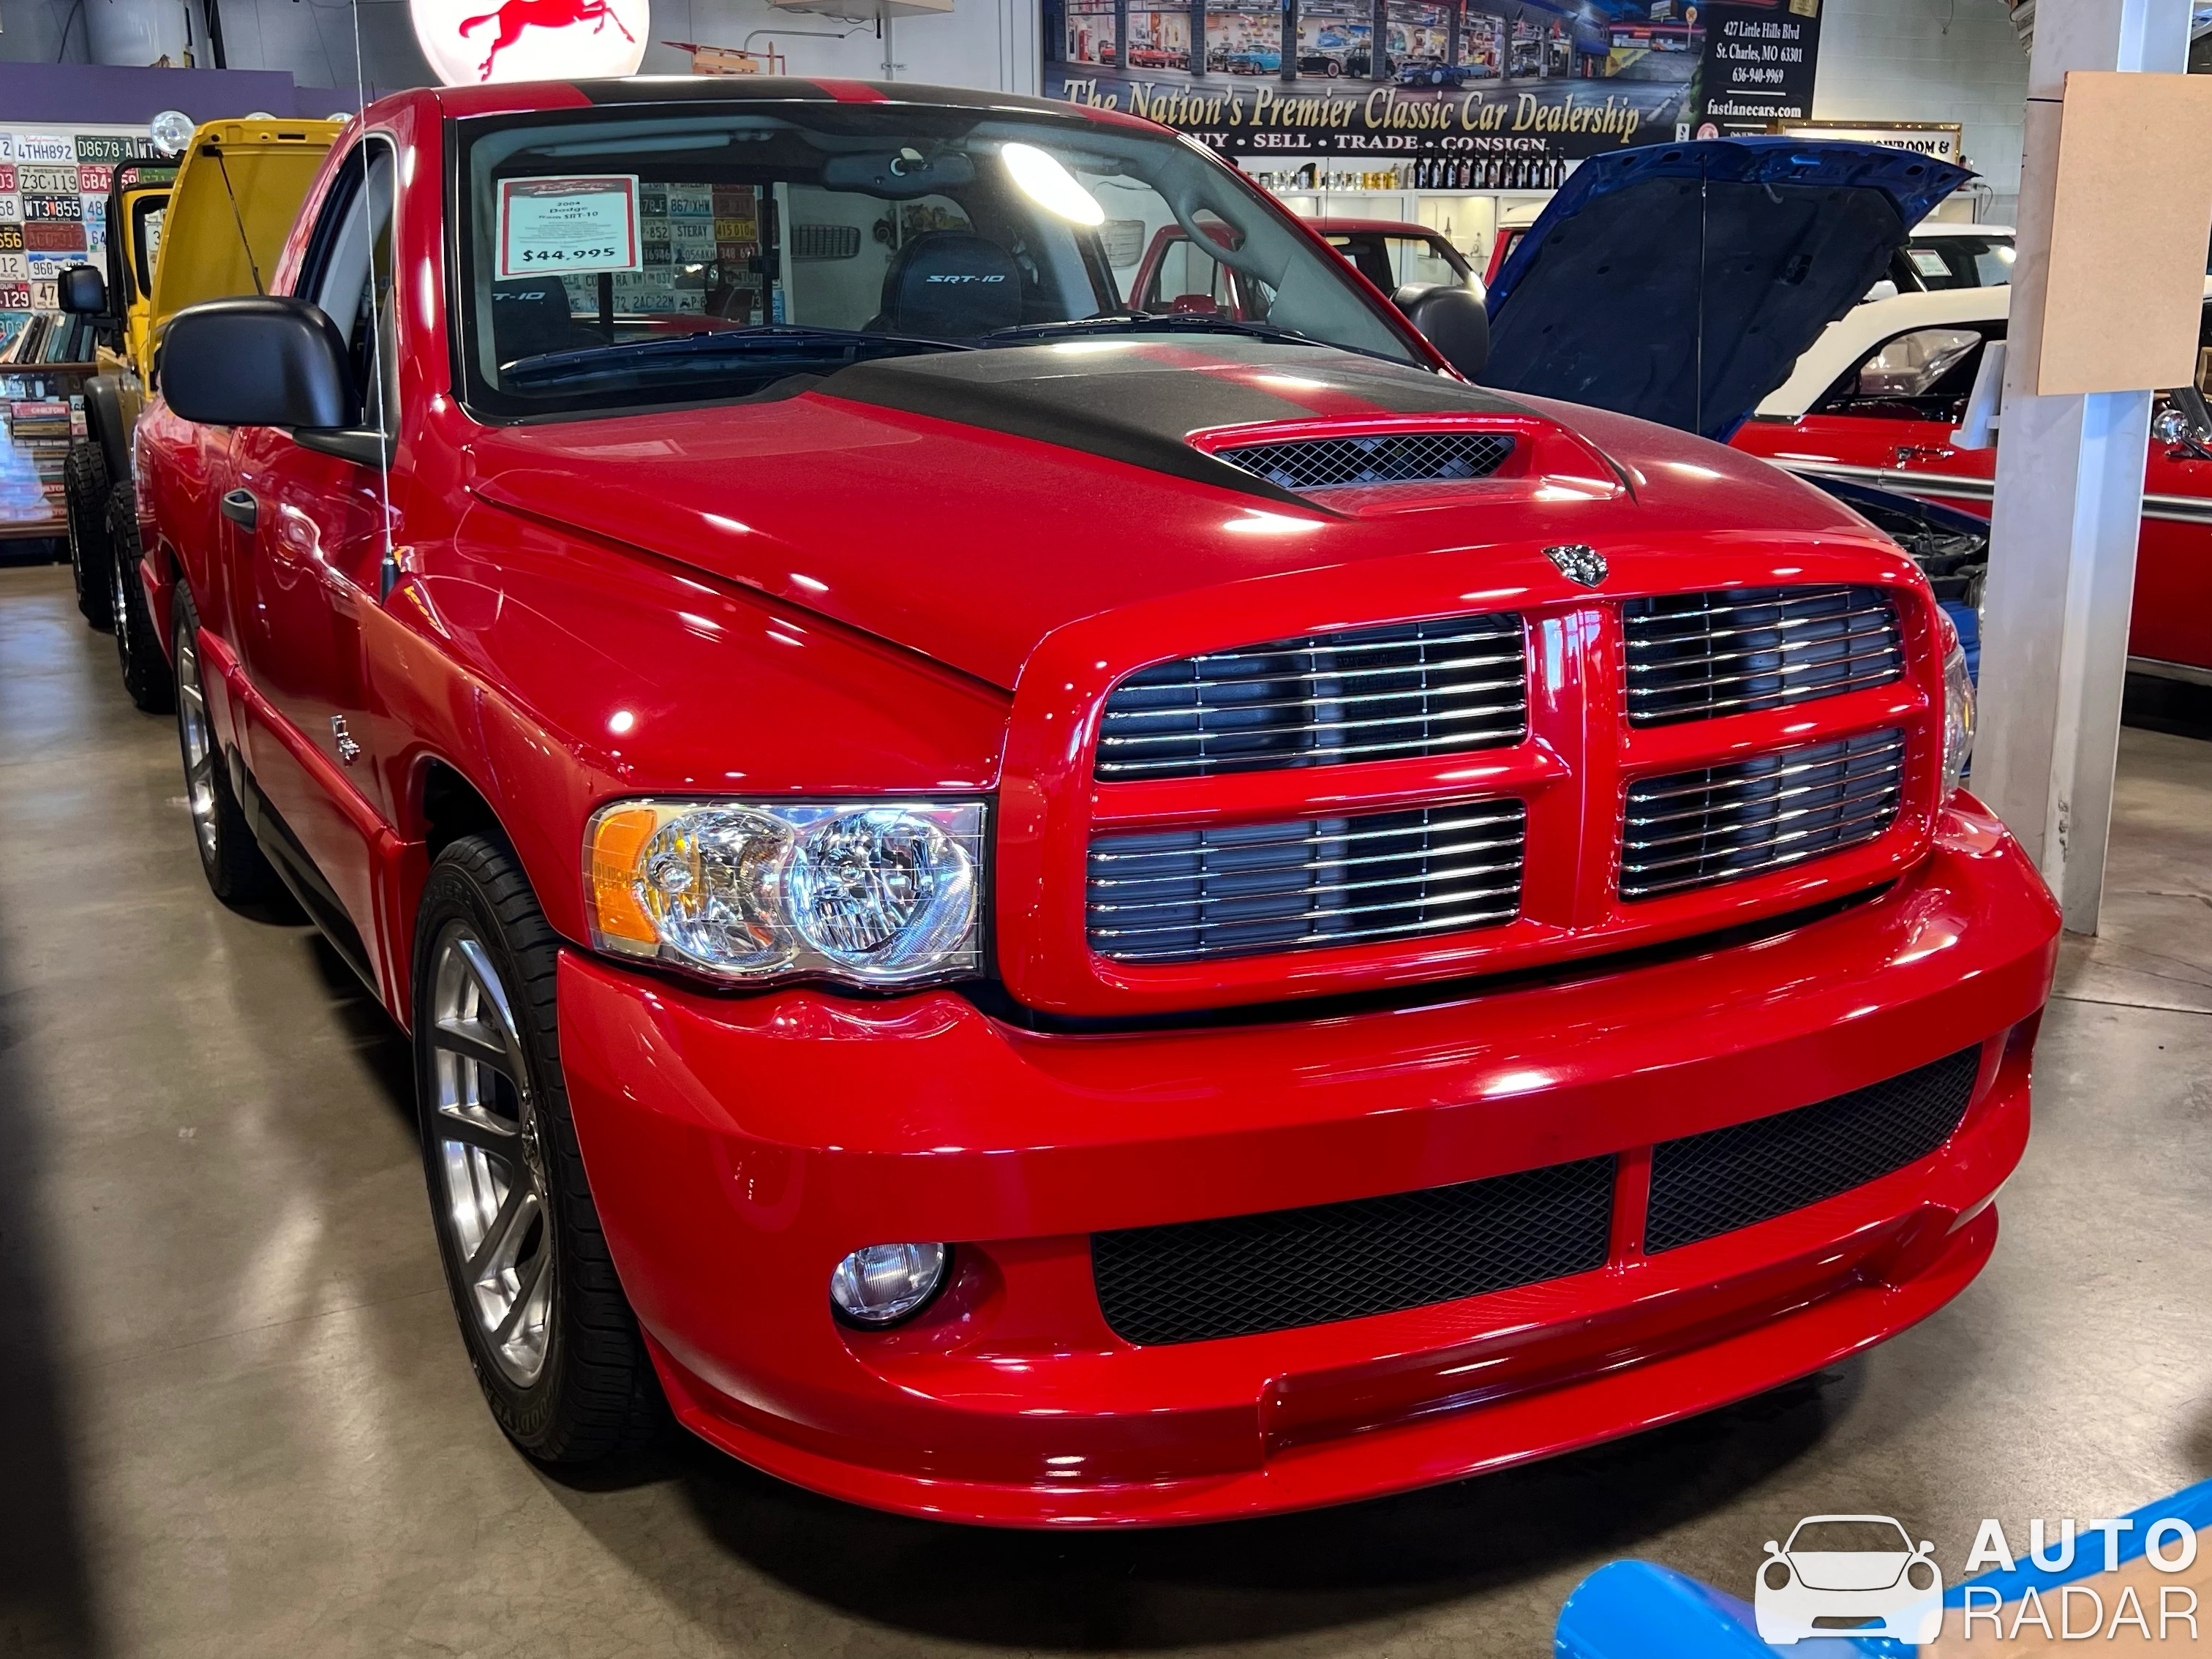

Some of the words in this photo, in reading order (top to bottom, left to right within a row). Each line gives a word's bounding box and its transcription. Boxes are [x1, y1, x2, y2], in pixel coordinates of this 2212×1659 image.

[1723, 20, 1737, 36] 427
[1739, 20, 1760, 38] Little
[1762, 23, 1780, 39] Hills
[1782, 24, 1800, 40] Blvd
[1716, 42, 1728, 59] St.
[1729, 43, 1760, 63] Charles,
[1761, 45, 1778, 61] MO
[1781, 47, 1802, 63] 63301
[1732, 67, 1784, 83] 636-940-9969
[1063, 78, 1118, 110] The
[1129, 82, 1244, 126] Nation's
[1249, 86, 1358, 128] Premier
[1364, 87, 1454, 129] Classic
[1462, 91, 1509, 131] Car
[1511, 93, 1639, 144] Dealership
[1707, 99, 1802, 118] fastlanecars.com
[1191, 133, 1230, 148] UY
[1253, 134, 1312, 148] SELL
[1334, 135, 1418, 149] TRADE
[1441, 137, 1547, 151] CONSIGN
[18, 144, 72, 159] 4THH892
[522, 247, 616, 262] $44,995
[925, 274, 1006, 285] SRT-10
